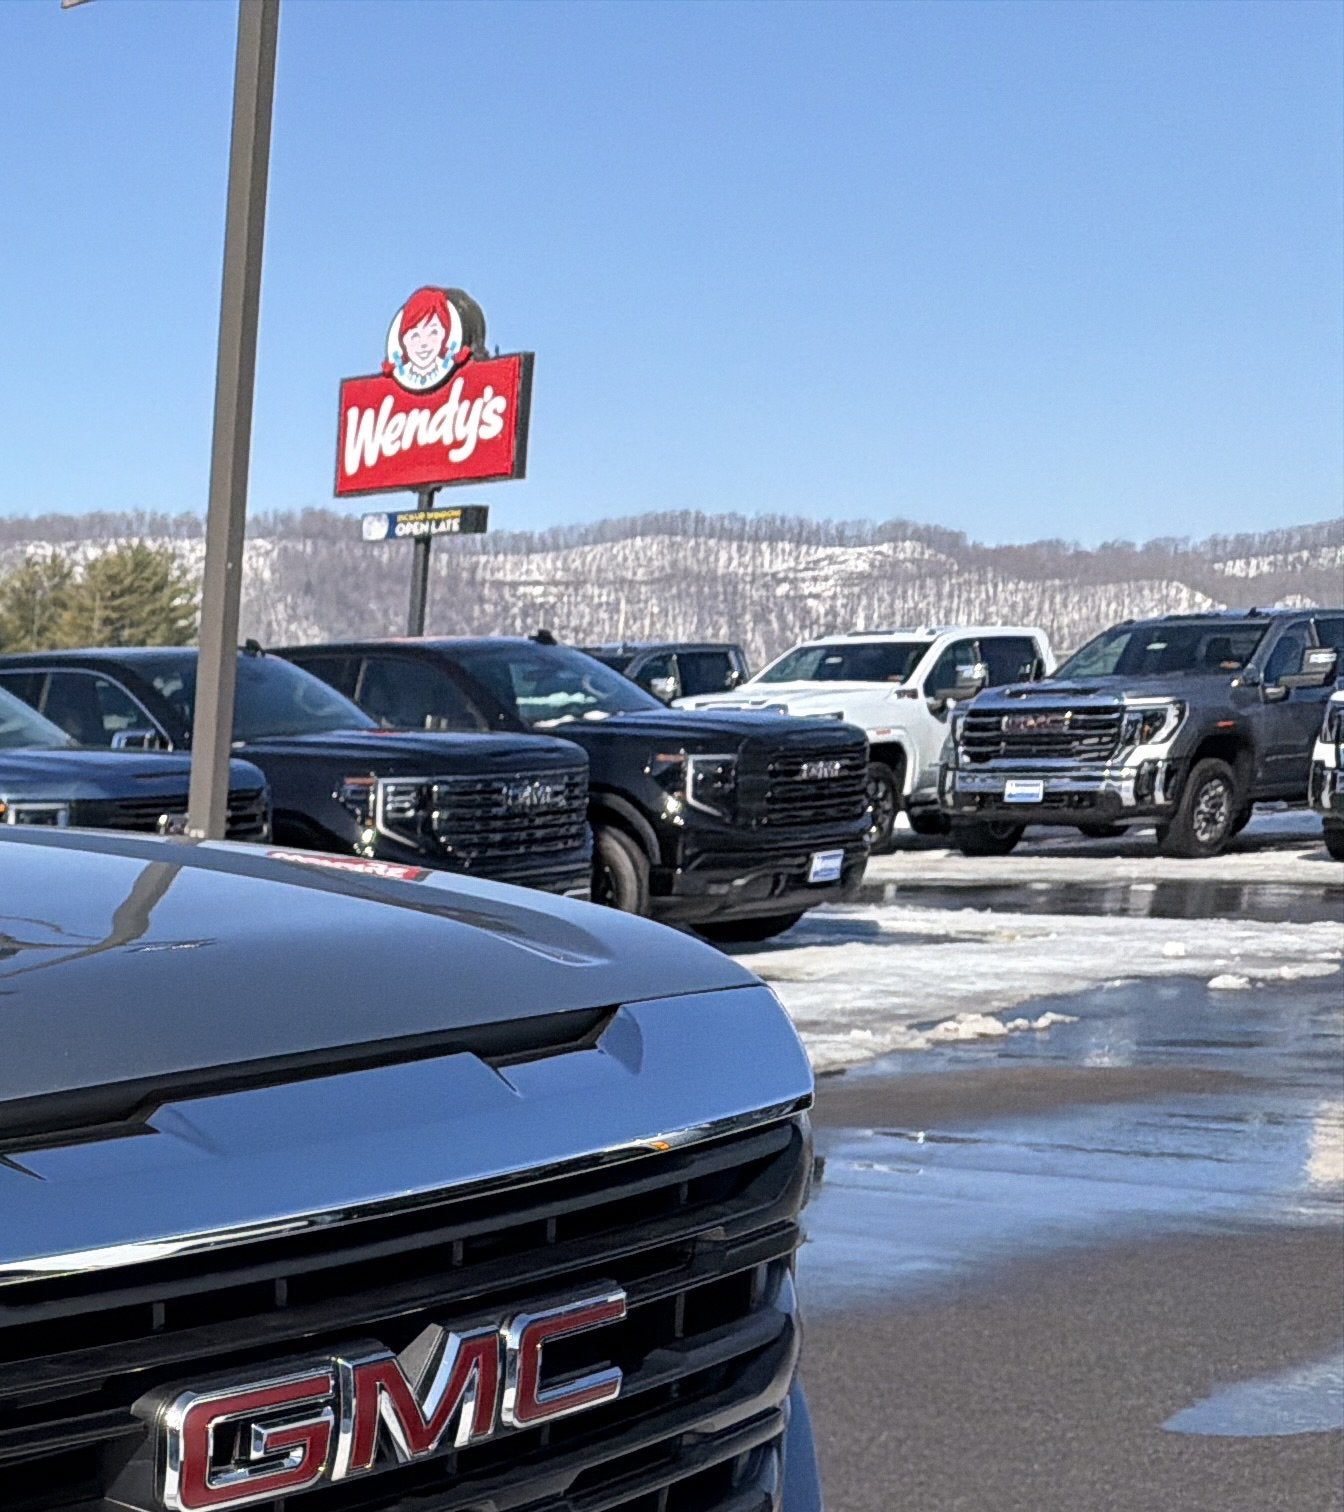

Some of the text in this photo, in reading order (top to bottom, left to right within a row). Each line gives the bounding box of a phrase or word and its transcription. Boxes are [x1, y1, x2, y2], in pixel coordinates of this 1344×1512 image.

[345, 377, 507, 476] Wendy's
[395, 518, 460, 536] OPEN LATE
